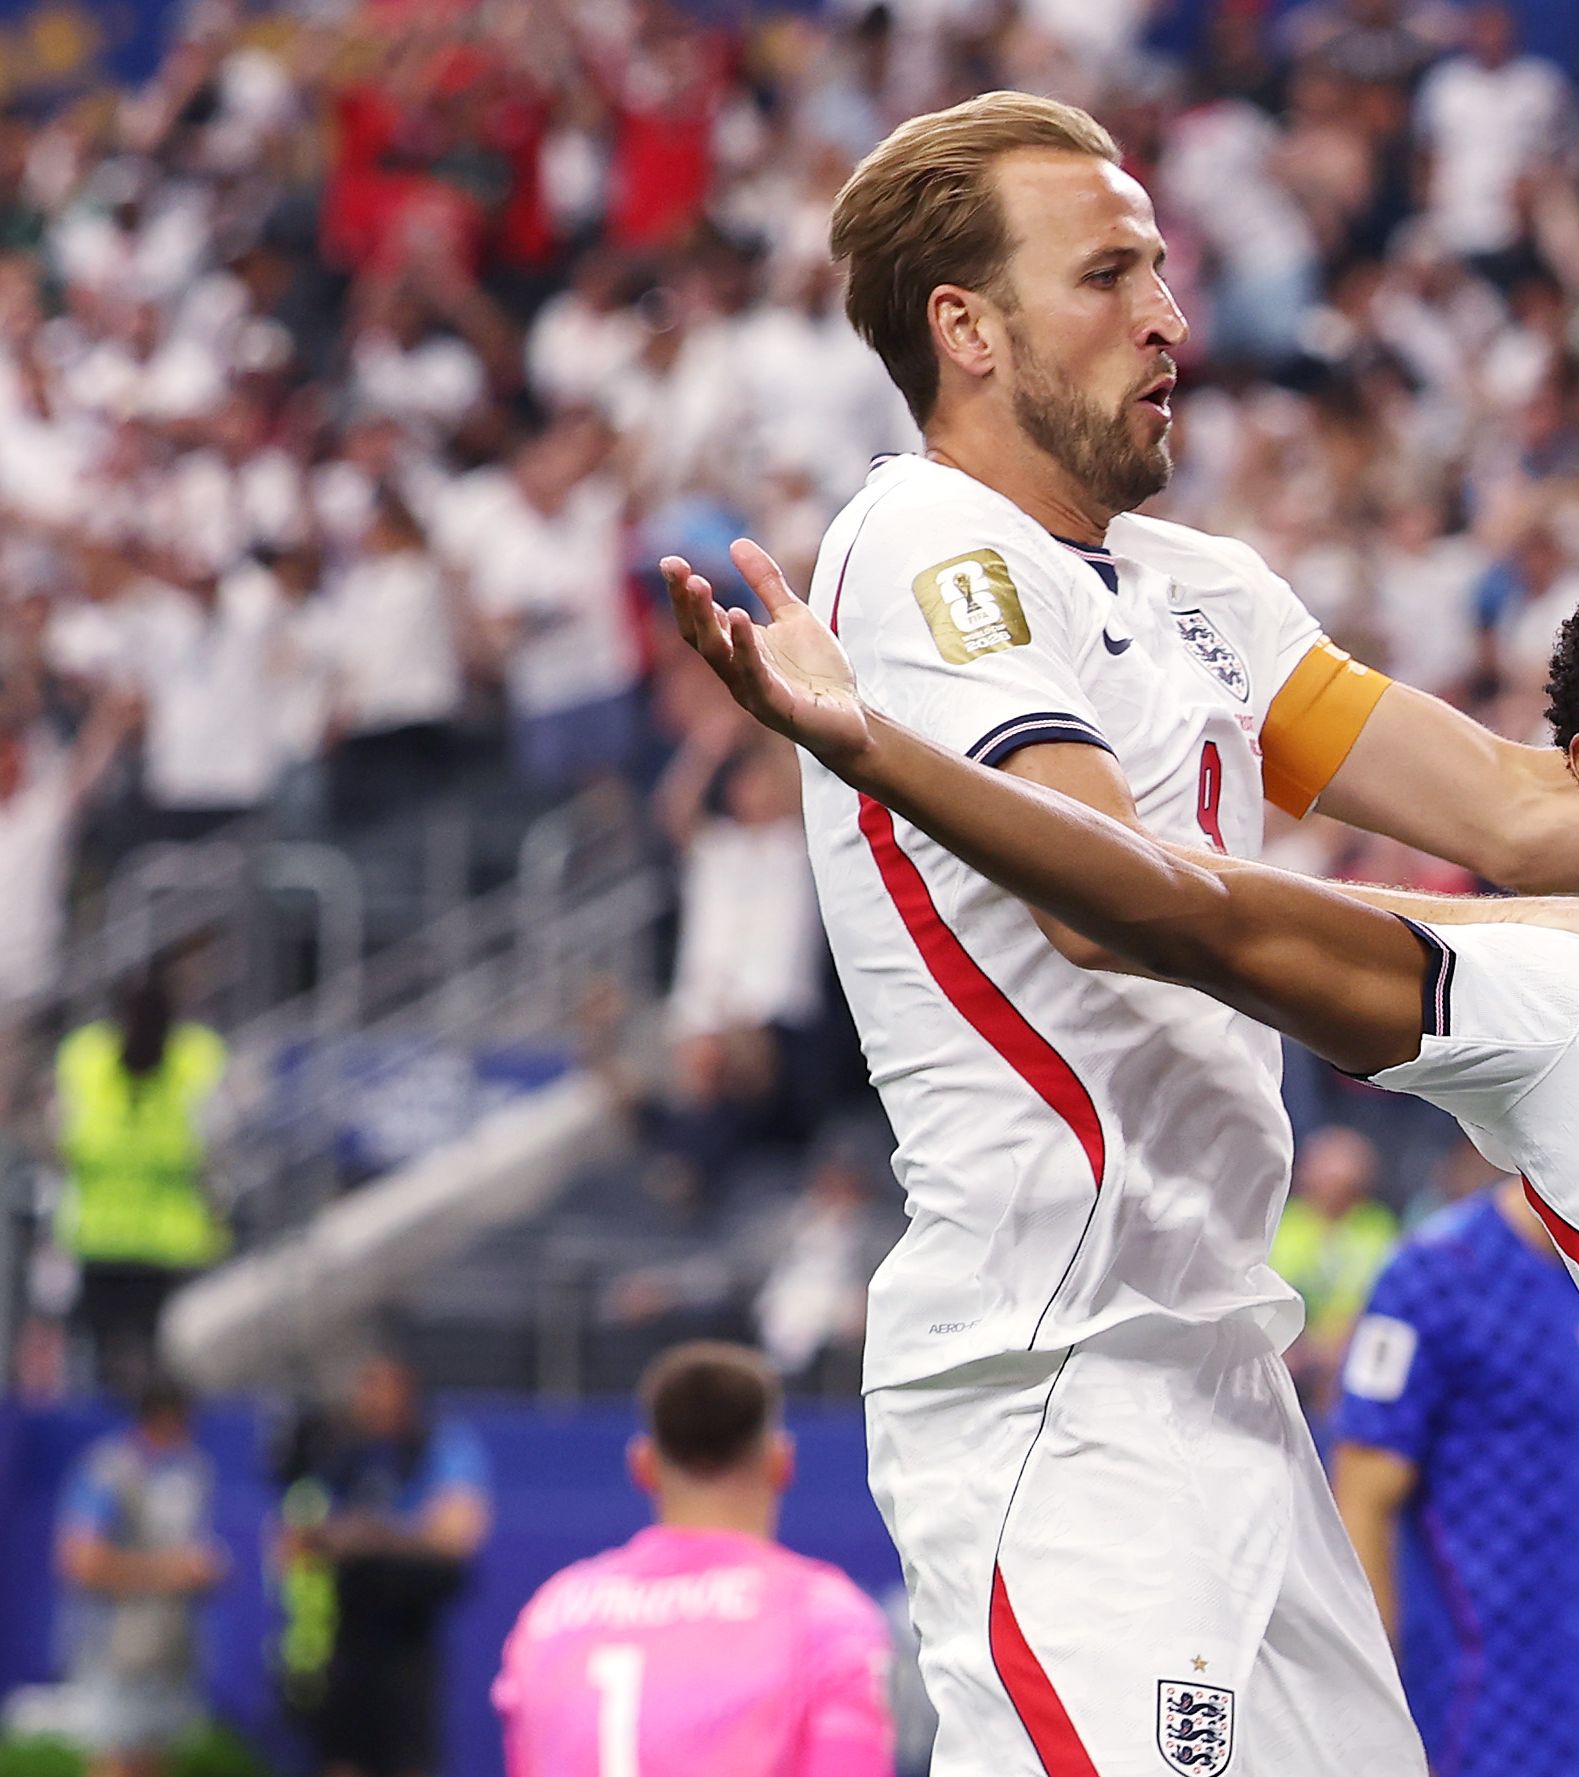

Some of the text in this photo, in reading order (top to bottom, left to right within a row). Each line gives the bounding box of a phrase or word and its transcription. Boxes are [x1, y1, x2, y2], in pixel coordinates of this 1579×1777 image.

[968, 613, 989, 625] FIFA
[965, 631, 1011, 653] 2026
[587, 1644, 645, 1777] 1
